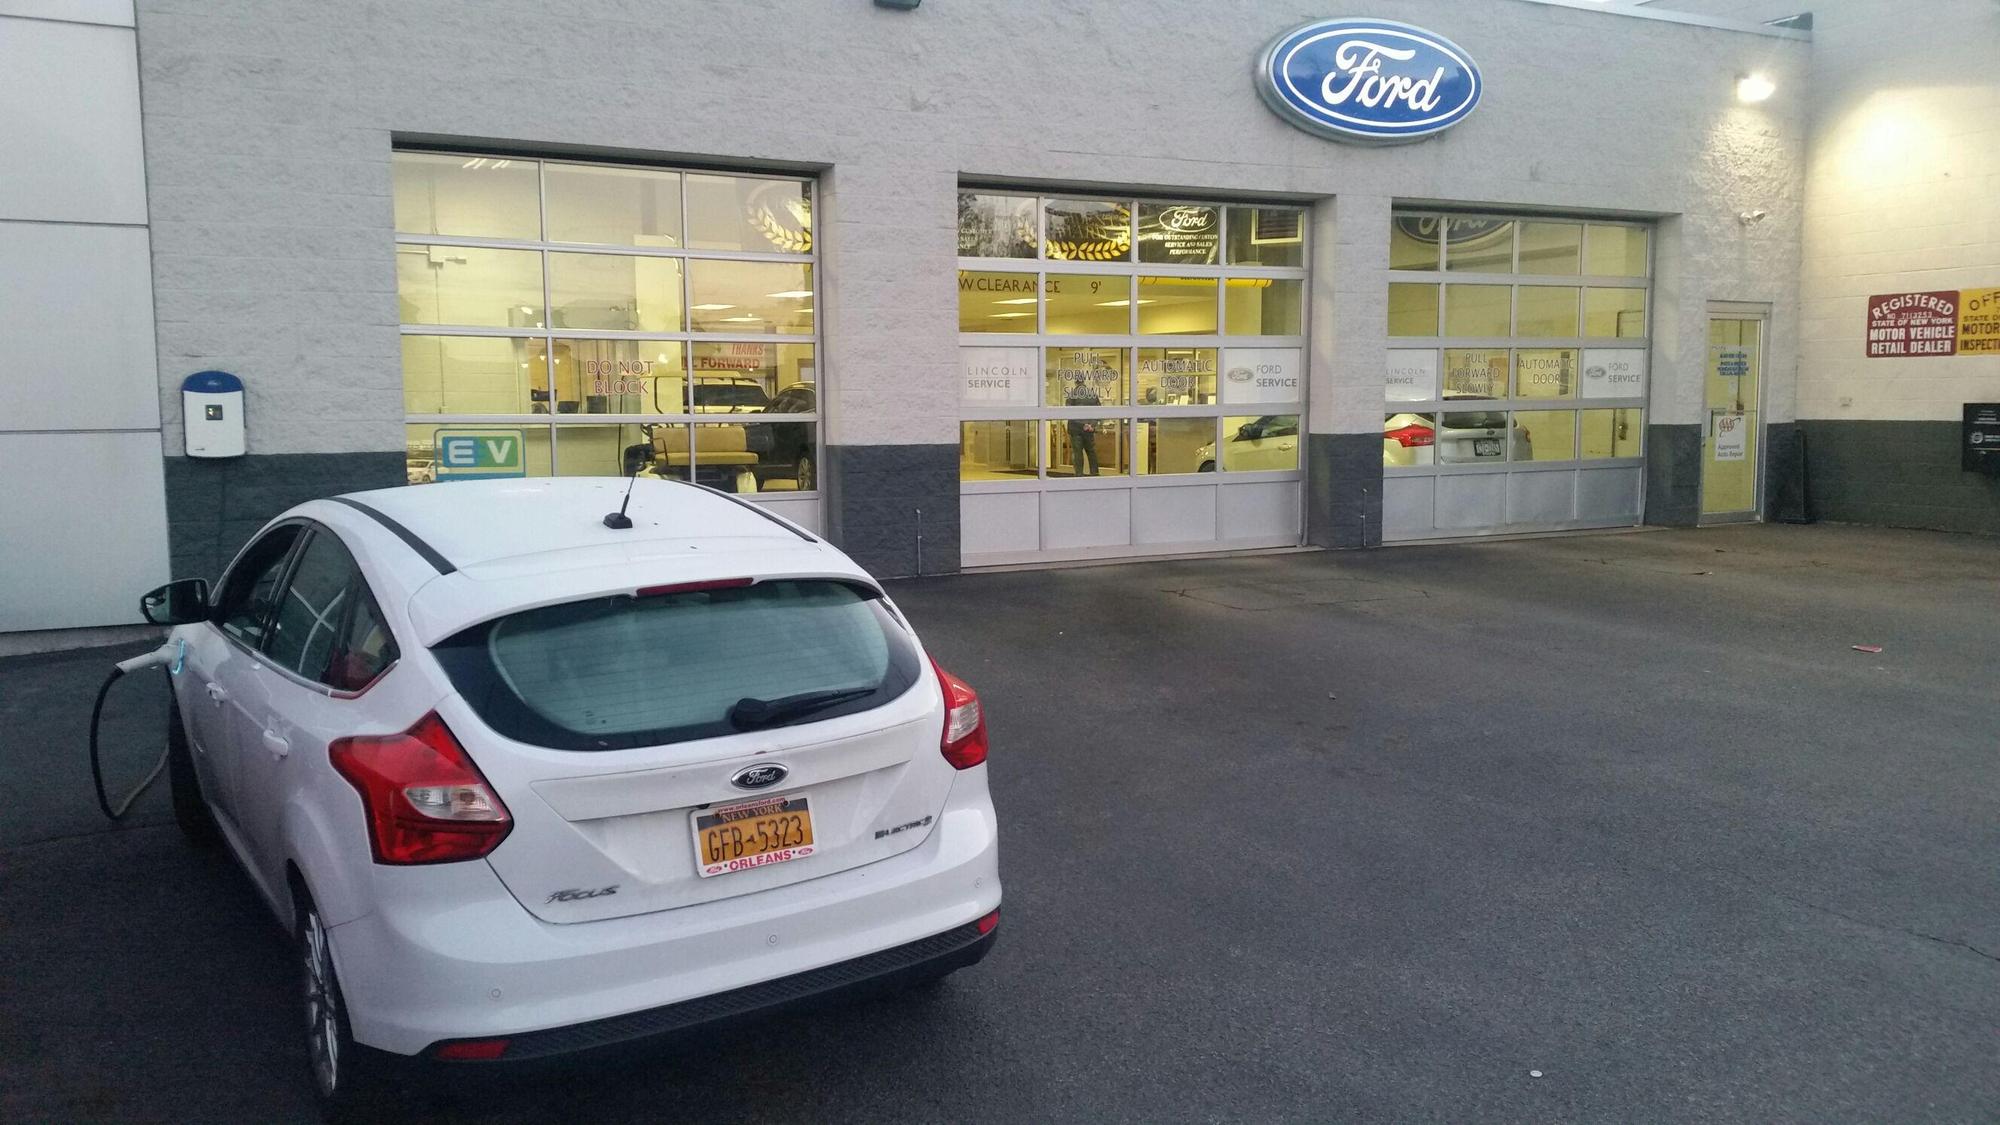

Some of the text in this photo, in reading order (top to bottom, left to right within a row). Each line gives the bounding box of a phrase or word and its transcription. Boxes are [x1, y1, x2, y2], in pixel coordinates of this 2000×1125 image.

[1321, 40, 1445, 112] Ford
[1171, 210, 1208, 227] Ford
[1872, 294, 1954, 320] REGISTERED
[1871, 319, 1895, 327] STATE
[1910, 318, 1929, 326] NEW
[1963, 314, 1988, 322] STATE
[1869, 325, 1956, 341] MOTOR VEHICLE
[1962, 323, 2000, 335] MOTOR
[731, 343, 764, 356] THANKS
[1871, 340, 1952, 355] RETAIL DEALER
[1960, 338, 2000, 351] INSPECT
[700, 357, 761, 369] FORWARD
[1074, 352, 1100, 364] PULL
[1465, 352, 1488, 364] PULL
[587, 360, 654, 374] DO NOT
[967, 366, 1028, 376] LINCOLN
[1142, 359, 1213, 373] AUTOMATIC
[1256, 364, 1282, 375] FORD
[1385, 367, 1426, 376] LINCOLN
[1608, 362, 1629, 372] FORD
[1057, 369, 1119, 381] FORWARD
[1452, 367, 1500, 379] FORWARD
[1533, 372, 1561, 385] DOOR
[1608, 374, 1641, 384] SERVICE
[595, 380, 649, 394] BLOCK
[967, 379, 1011, 389] SERVICE
[1160, 375, 1197, 389] DOOR
[1256, 378, 1297, 388] SERVICE
[1385, 377, 1415, 385] SERVICE
[1063, 386, 1112, 399] SLOWLY
[1456, 382, 1495, 394] SLOWLY
[448, 440, 512, 464] EV
[746, 768, 776, 785] Ford
[722, 803, 783, 823] NEW YORK
[729, 850, 792, 871] ORLEANS
